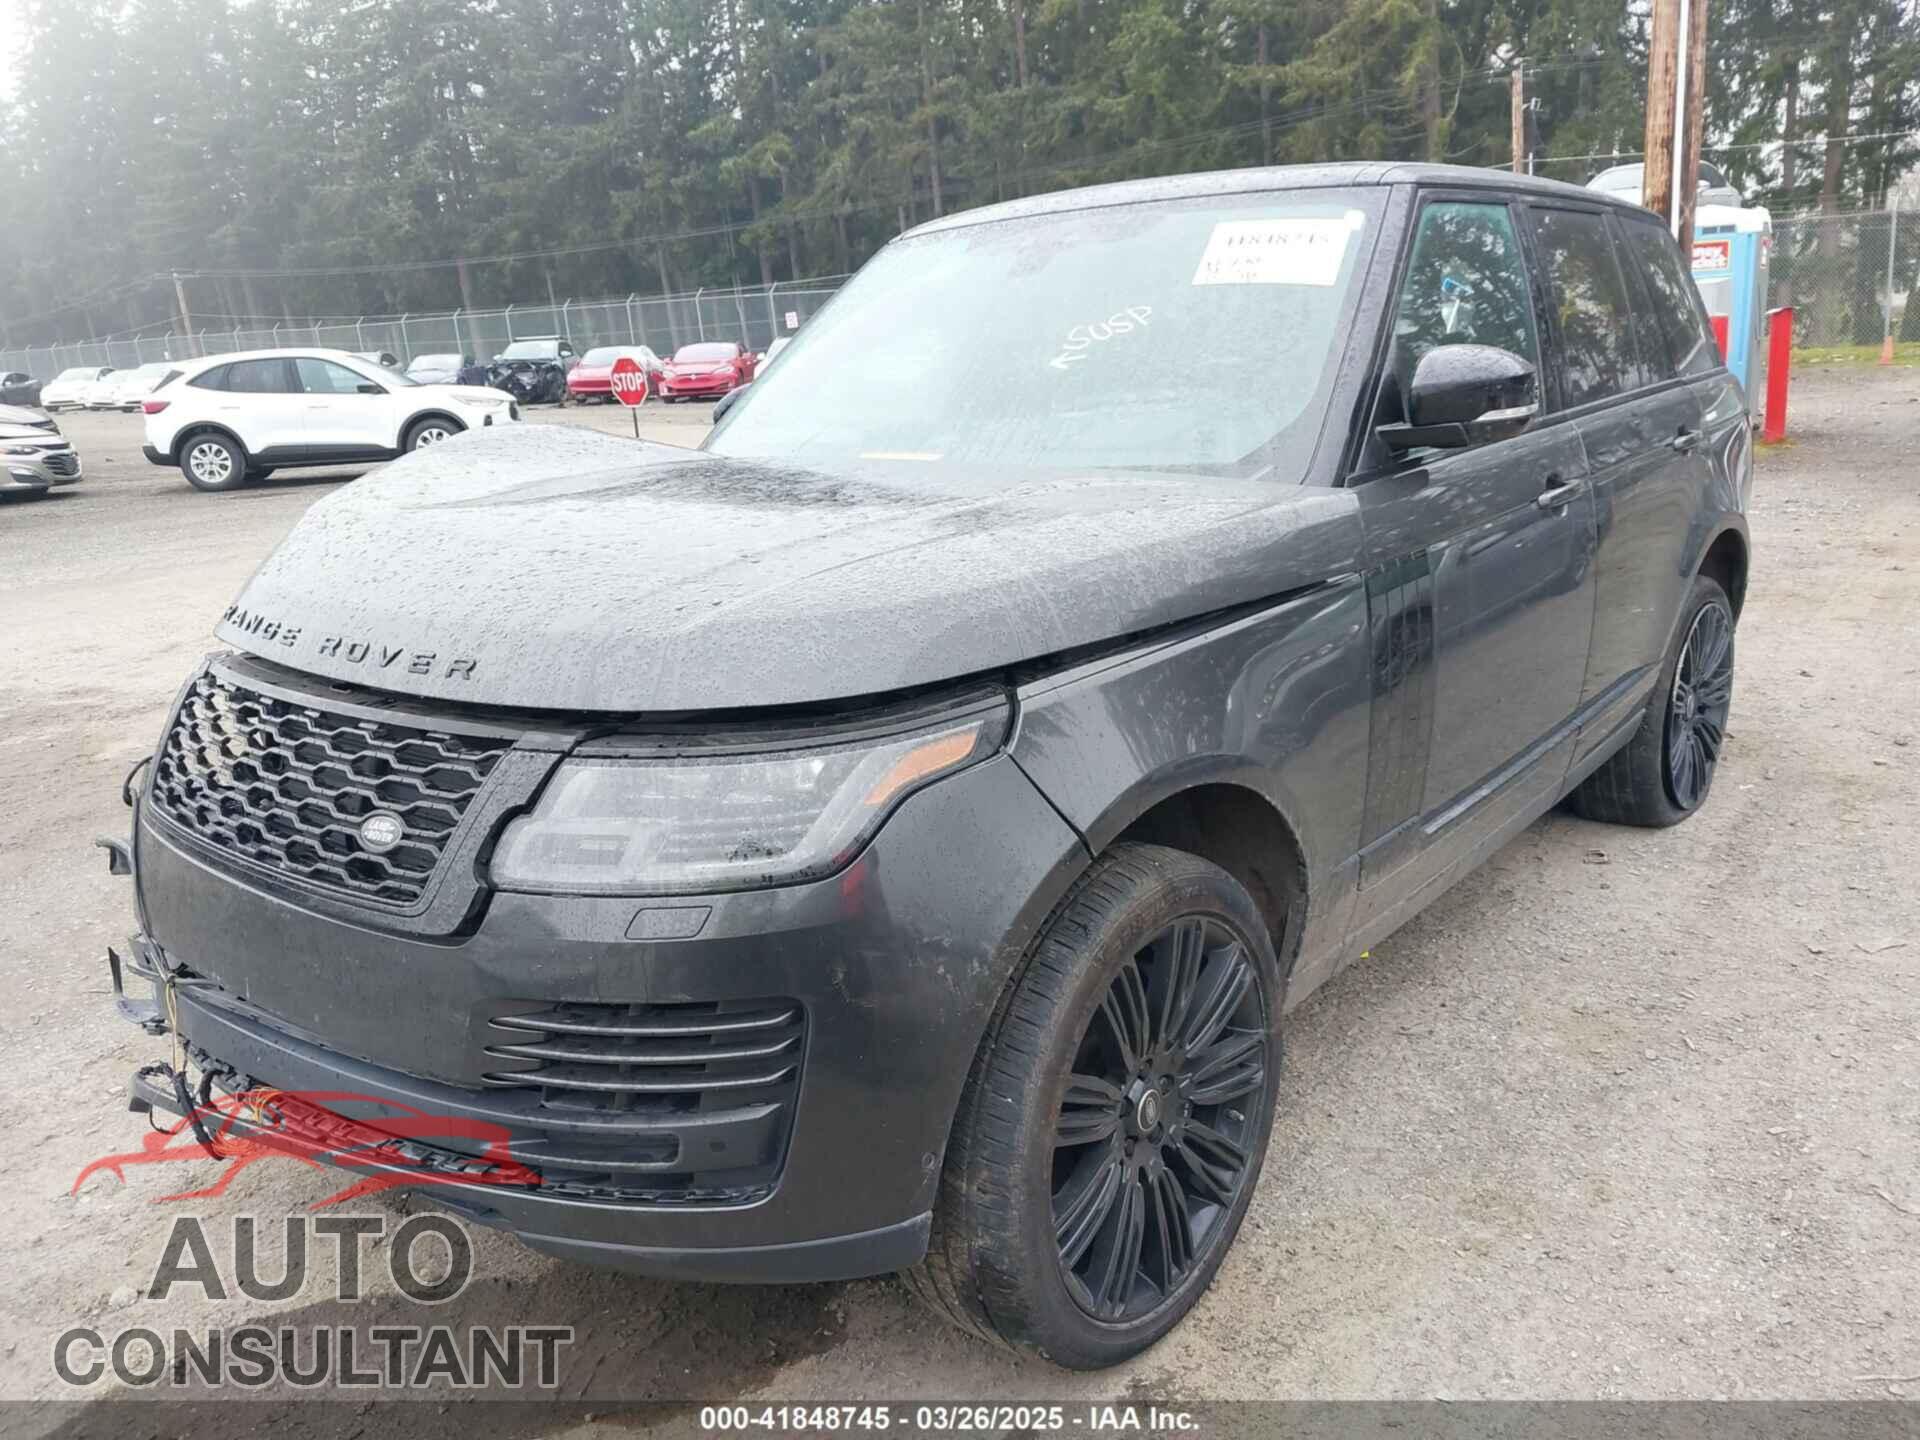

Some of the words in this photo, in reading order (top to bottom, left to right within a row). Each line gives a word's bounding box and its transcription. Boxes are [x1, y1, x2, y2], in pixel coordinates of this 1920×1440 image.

[1064, 305, 1153, 351] SUSP
[613, 372, 643, 392] STOP
[224, 605, 301, 648] RANGE
[319, 637, 478, 681] ROVER
